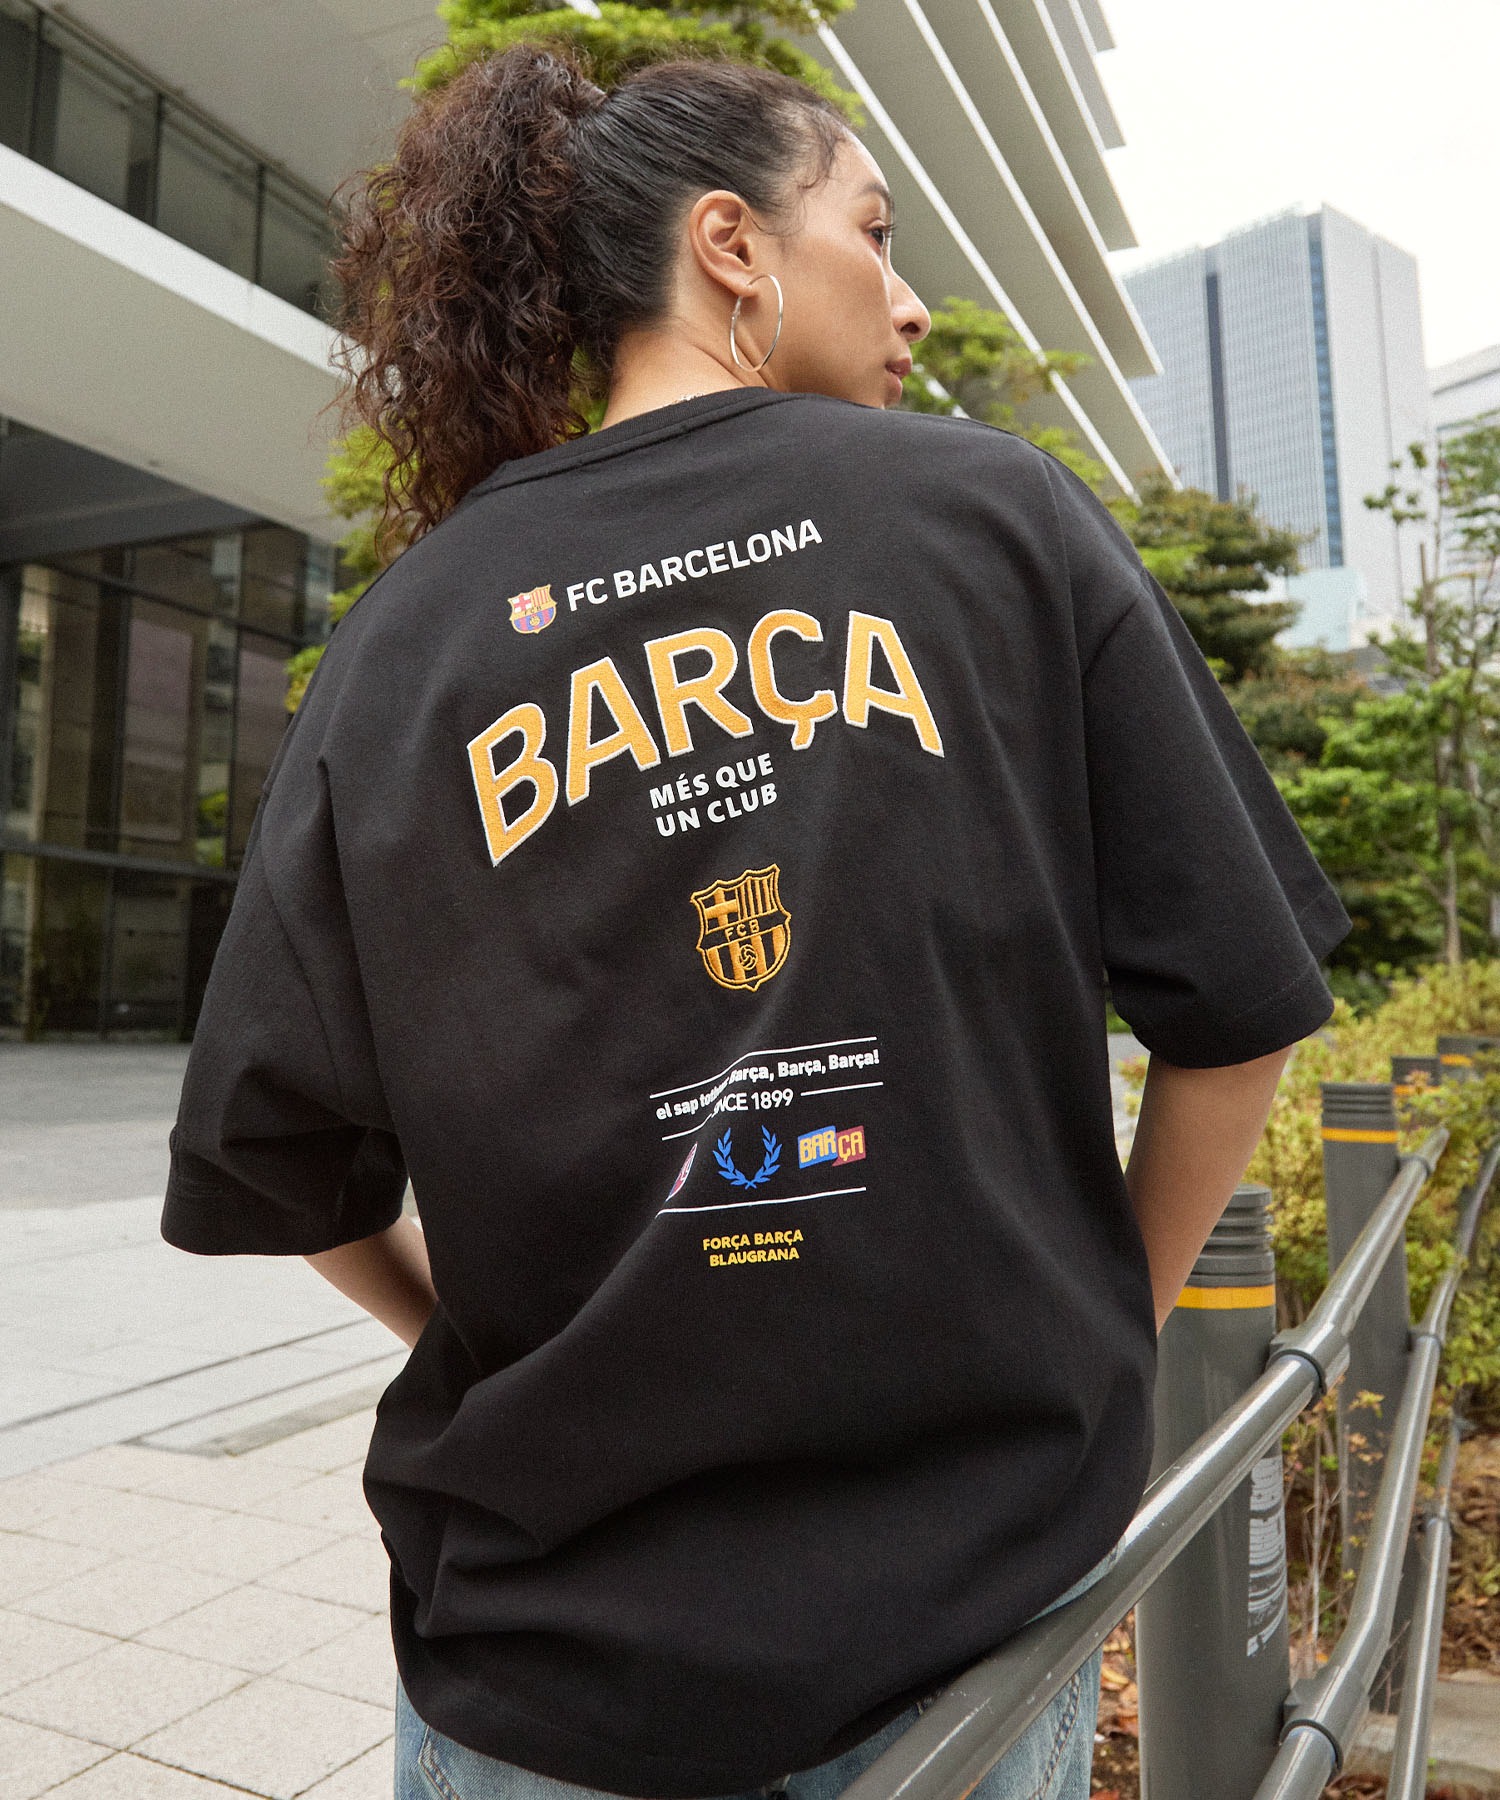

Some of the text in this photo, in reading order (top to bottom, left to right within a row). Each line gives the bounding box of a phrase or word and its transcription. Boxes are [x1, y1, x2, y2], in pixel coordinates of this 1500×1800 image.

[566, 518, 823, 612] FC BARCELONA
[467, 609, 945, 867] BARÇA
[649, 753, 774, 810] MÉS QUE
[655, 782, 779, 838] UN CLUB
[725, 918, 760, 943] FCB
[656, 1102, 672, 1120] el
[673, 1098, 699, 1115] sap
[777, 1055, 827, 1078] Barça,
[828, 1049, 880, 1071] Barça!
[751, 1088, 794, 1111] 1899
[799, 1130, 864, 1164] BARÇA
[702, 1229, 804, 1251] FORÇA BARÇA
[709, 1247, 800, 1267] BLAUGRANA
